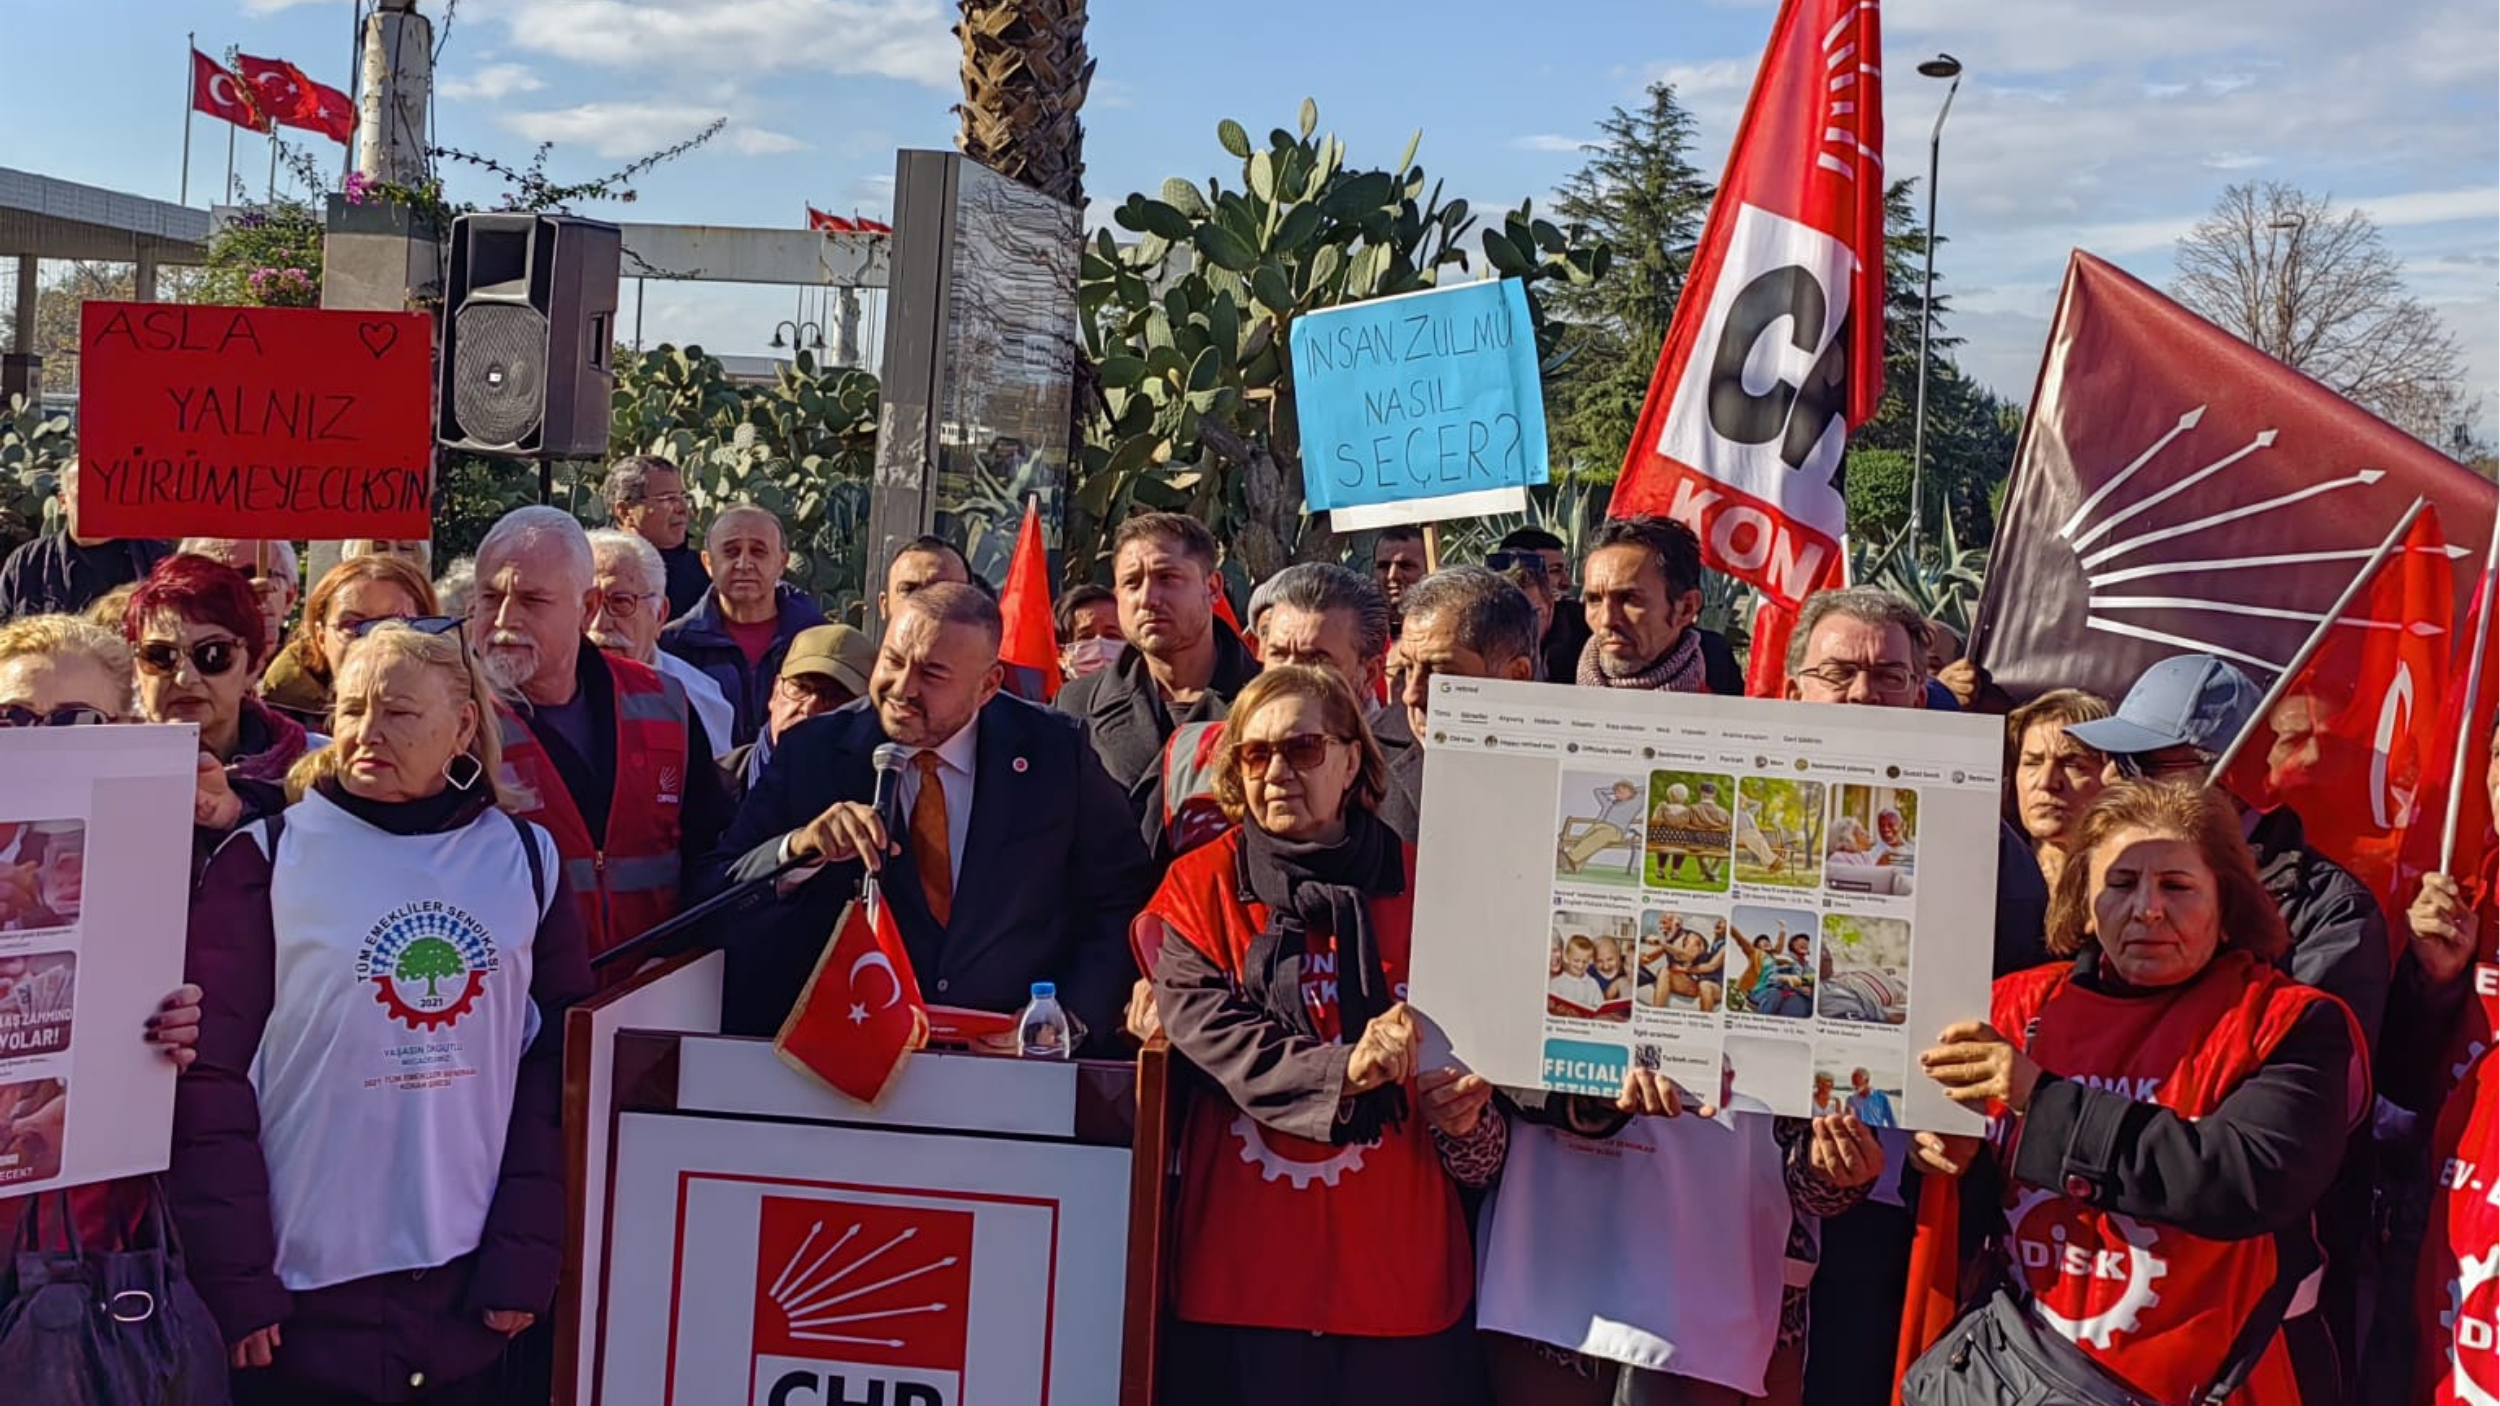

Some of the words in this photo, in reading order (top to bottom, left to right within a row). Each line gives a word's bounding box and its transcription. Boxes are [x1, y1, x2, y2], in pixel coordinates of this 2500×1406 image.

[94, 309, 263, 356] ASLA
[1303, 320, 1394, 380] İNSAN
[1404, 300, 1513, 362] ZULMÜ
[168, 386, 361, 442] YALNIZ
[1365, 377, 1464, 427] NASIL
[1336, 413, 1521, 489] SEÇER?
[355, 948, 373, 985] TÜM
[365, 900, 443, 946] EMEKLİLER
[447, 905, 499, 972] SENDİKASI
